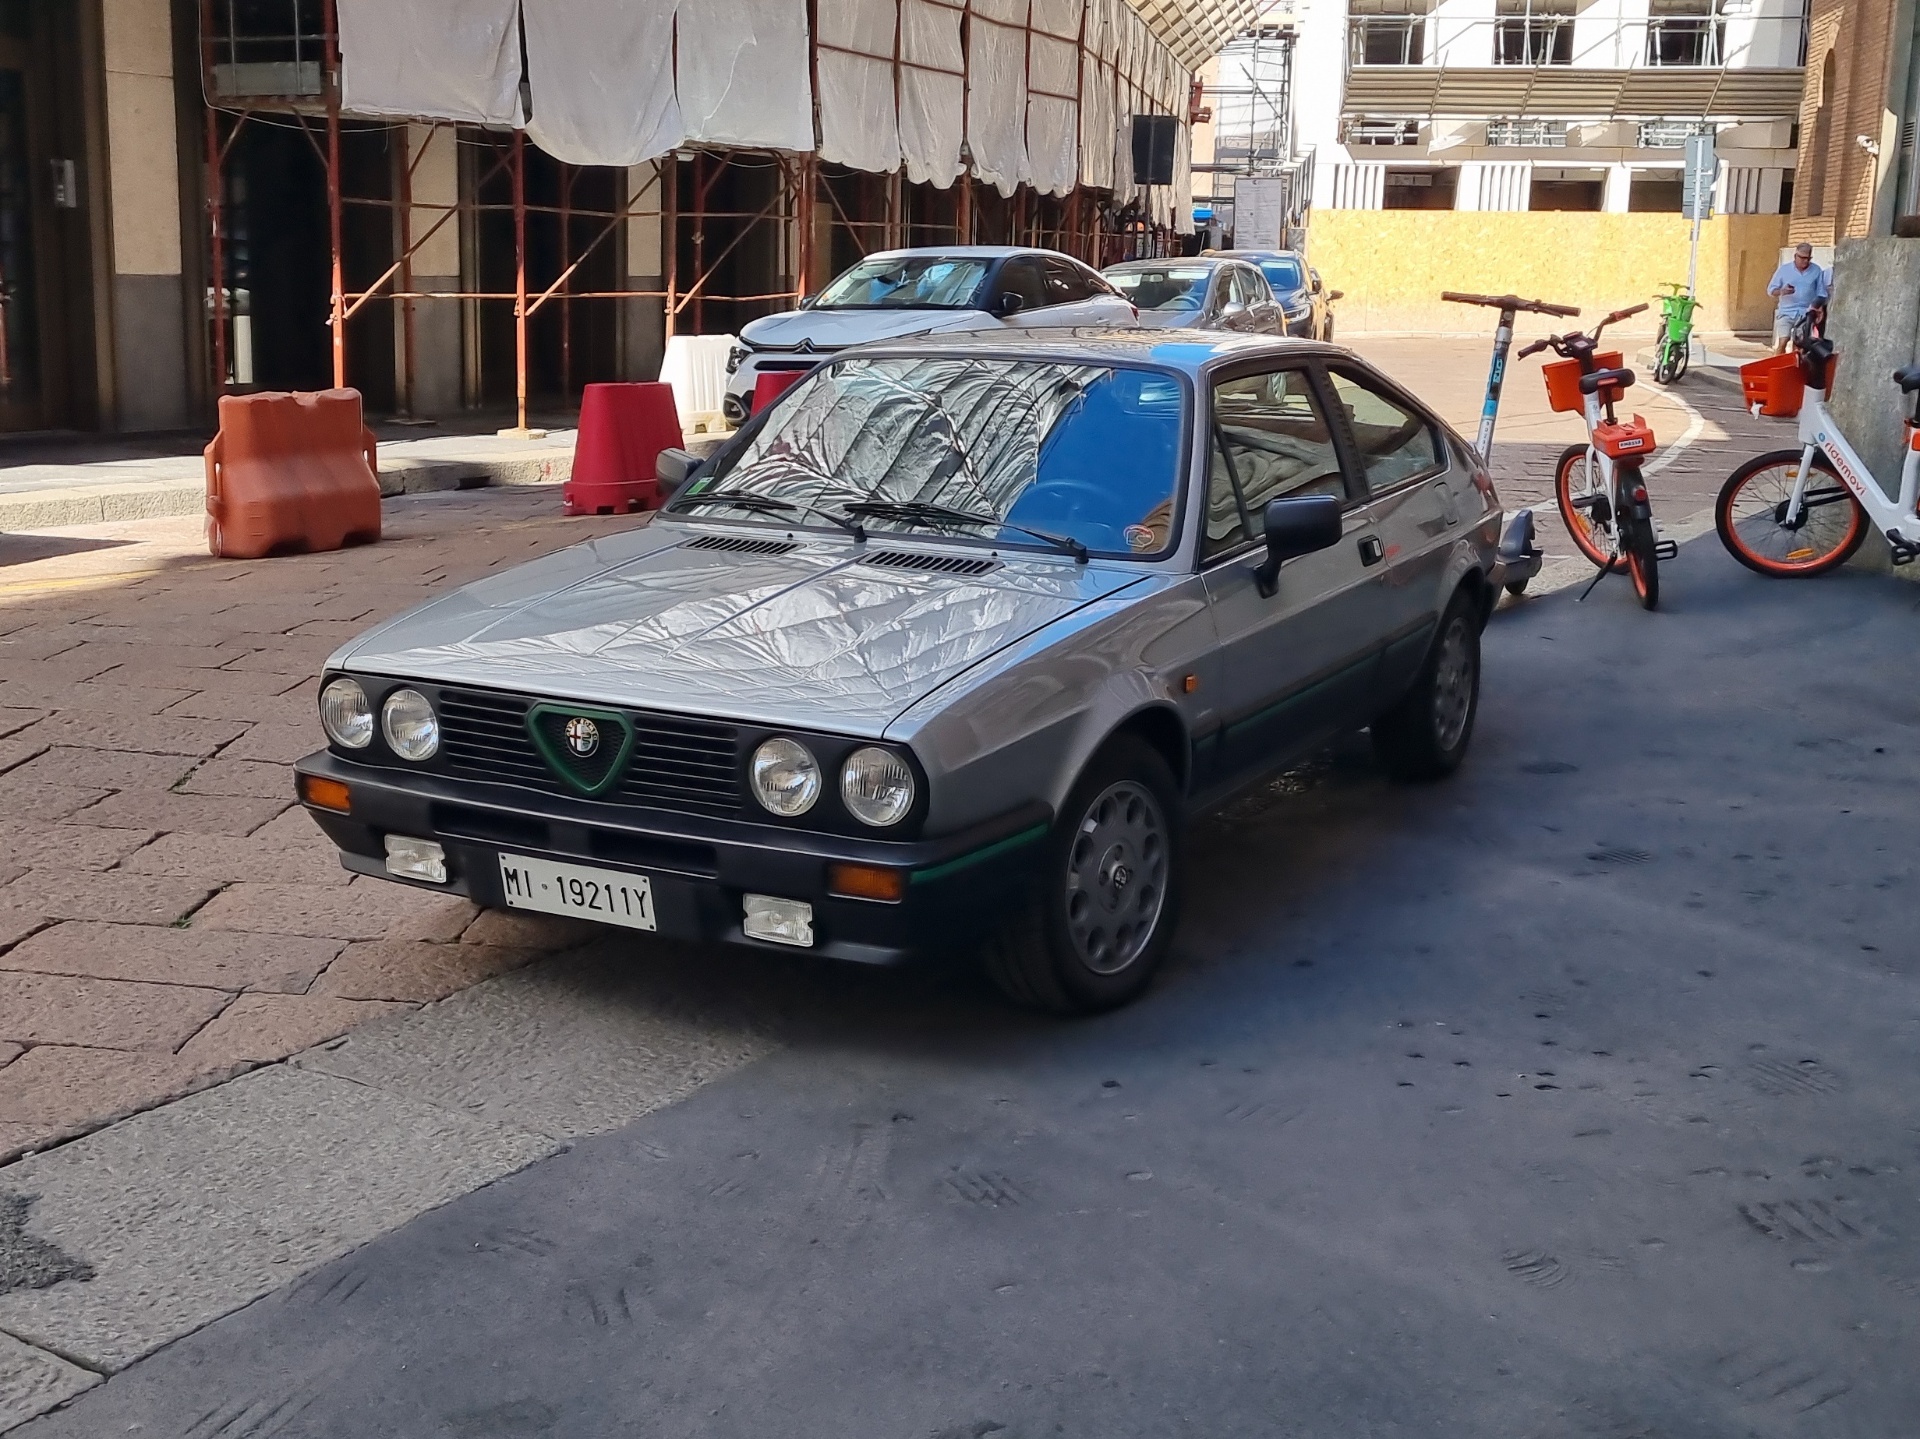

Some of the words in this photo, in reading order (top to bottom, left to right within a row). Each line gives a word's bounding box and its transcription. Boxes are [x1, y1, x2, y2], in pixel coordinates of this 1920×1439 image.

[1824, 442, 1867, 496] ridemovi
[503, 866, 532, 898] MI
[556, 875, 646, 918] 19211Y
